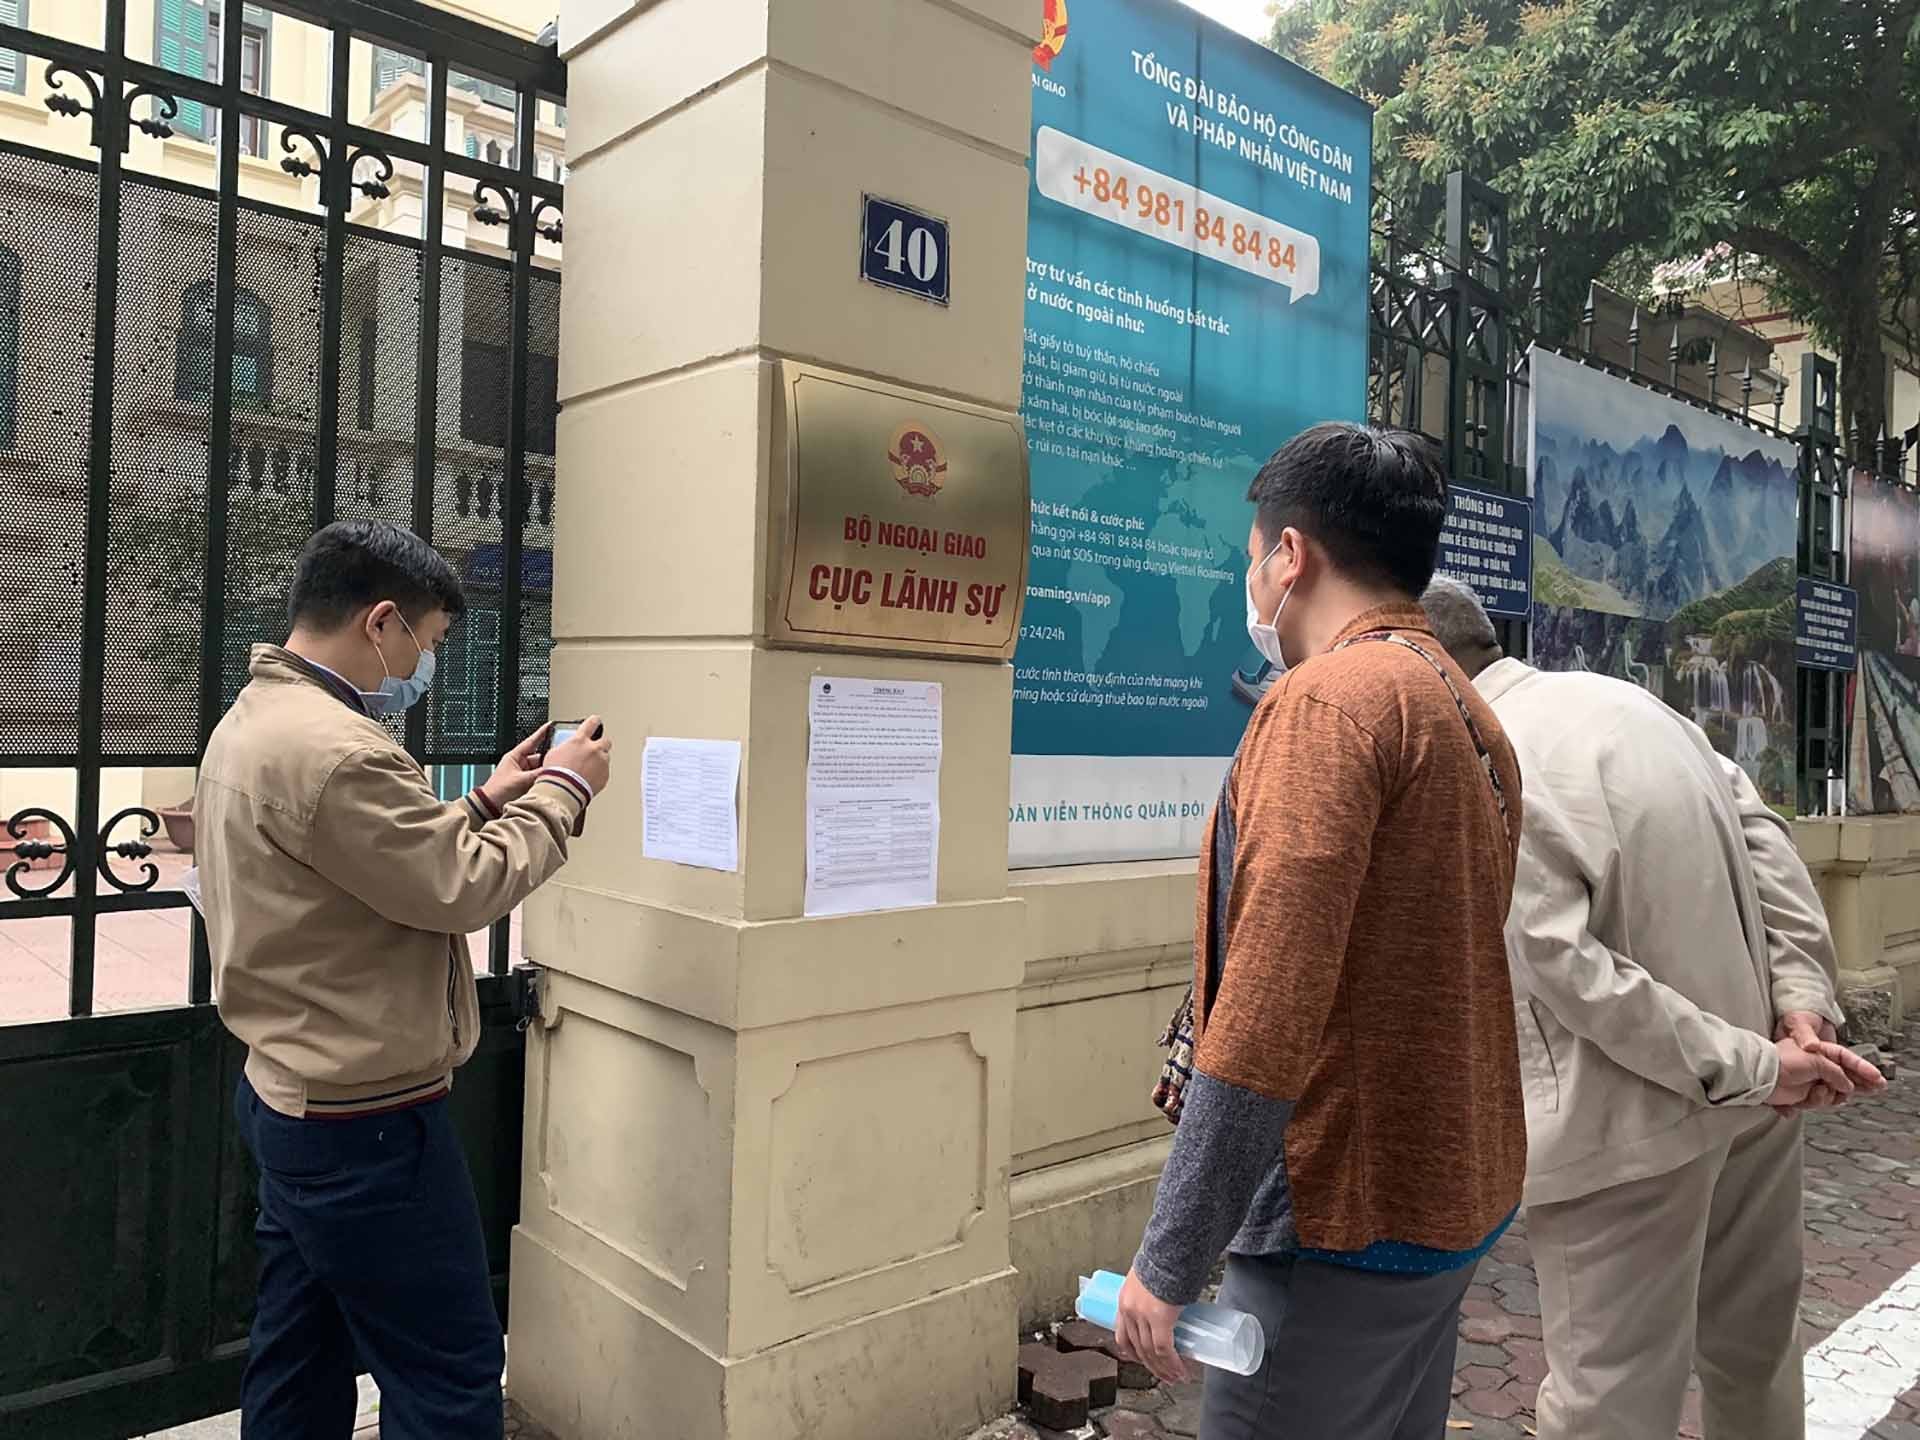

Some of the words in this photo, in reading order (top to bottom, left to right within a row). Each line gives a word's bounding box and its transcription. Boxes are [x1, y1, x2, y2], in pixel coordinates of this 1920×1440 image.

[1041, 77, 1066, 98] GIAO
[1131, 50, 1181, 94] TỔNG
[1184, 77, 1214, 110] ĐÀI
[1217, 92, 1250, 126] BẢO
[1254, 110, 1276, 143] HỘ
[1279, 123, 1320, 160] CÔNG
[1322, 143, 1353, 175] DÂN
[1165, 100, 1190, 132] VÀ
[1192, 114, 1236, 150] PHÁP
[1239, 137, 1284, 174] NHÂN
[1286, 157, 1318, 191] VIỆT
[1319, 173, 1352, 205] NAM
[1073, 165, 1129, 210] +84
[1136, 185, 1186, 232] 981
[1193, 207, 1226, 247] 84
[1231, 222, 1262, 262] 84
[1267, 236, 1297, 274] 84
[874, 219, 938, 282] 40
[1025, 256, 1047, 281] trợ
[1049, 264, 1065, 283] tư
[1066, 270, 1091, 292] vấn
[1094, 280, 1115, 300] các
[1145, 294, 1185, 325] huống
[1187, 307, 1207, 329] bất
[1208, 316, 1230, 336] trắc
[1027, 281, 1038, 301] ở
[1040, 290, 1074, 313] nước
[1076, 302, 1114, 325] ngoài
[1116, 312, 1145, 334] như:
[1039, 334, 1061, 352] giấy
[1134, 359, 1160, 377] chiếu
[1035, 373, 1065, 393] thành
[1067, 384, 1086, 401] nạn
[1088, 388, 1113, 406] nhân
[1114, 394, 1131, 410] của
[1133, 399, 1146, 414] tội
[1050, 355, 1060, 374] bị
[1062, 361, 1088, 377] giam
[1109, 372, 1119, 390] bị
[1157, 387, 1184, 403] ngoài
[1072, 403, 1083, 421] bị
[1083, 406, 1103, 423] bóc
[1103, 411, 1117, 427] lột
[1135, 418, 1151, 434] lao
[1085, 427, 1104, 443] khu
[1036, 438, 1049, 453] rủi
[1066, 445, 1080, 459] tai
[1081, 450, 1100, 465] nạn
[1052, 503, 1070, 519] kết
[1071, 508, 1089, 521] nối
[1090, 510, 1098, 523] &
[1100, 514, 1124, 528] cước
[1454, 494, 1484, 514] THÔNG
[1485, 501, 1504, 518] BÁO
[843, 514, 872, 549] BỘ
[878, 522, 938, 557] NGOẠI
[943, 532, 987, 560] GIAO
[1031, 520, 1057, 541] hàng
[1077, 529, 1097, 543] +84
[1098, 531, 1115, 546] 981
[1117, 535, 1129, 547] 84
[1130, 536, 1143, 549] 84
[1144, 538, 1156, 552] 84
[1031, 544, 1051, 558] qua
[1053, 546, 1071, 560] nút
[1072, 546, 1093, 562] SOS
[1094, 552, 1120, 570] trong
[1142, 557, 1168, 576] dụng
[1168, 560, 1197, 576] Viettel
[1197, 566, 1234, 584] Roaming
[808, 564, 872, 610] CỤC
[880, 569, 958, 614] LÃNH
[964, 582, 1007, 625] SỰ
[1026, 585, 1111, 608] roaming.vn/app
[1029, 625, 1065, 640] 24/24h
[1063, 668, 1084, 682] theo
[1086, 673, 1104, 687] quy
[1105, 672, 1126, 687] định
[1127, 672, 1144, 686] của
[1040, 688, 1065, 705] hoặc
[1079, 690, 1104, 708] dụng
[1105, 691, 1126, 705] thuê
[1127, 692, 1145, 705] bao
[1042, 800, 1078, 822] VIỄN
[1083, 803, 1133, 821] THÔNG
[1138, 802, 1177, 820] QUÂN
[1180, 800, 1205, 821] ĐỘI
